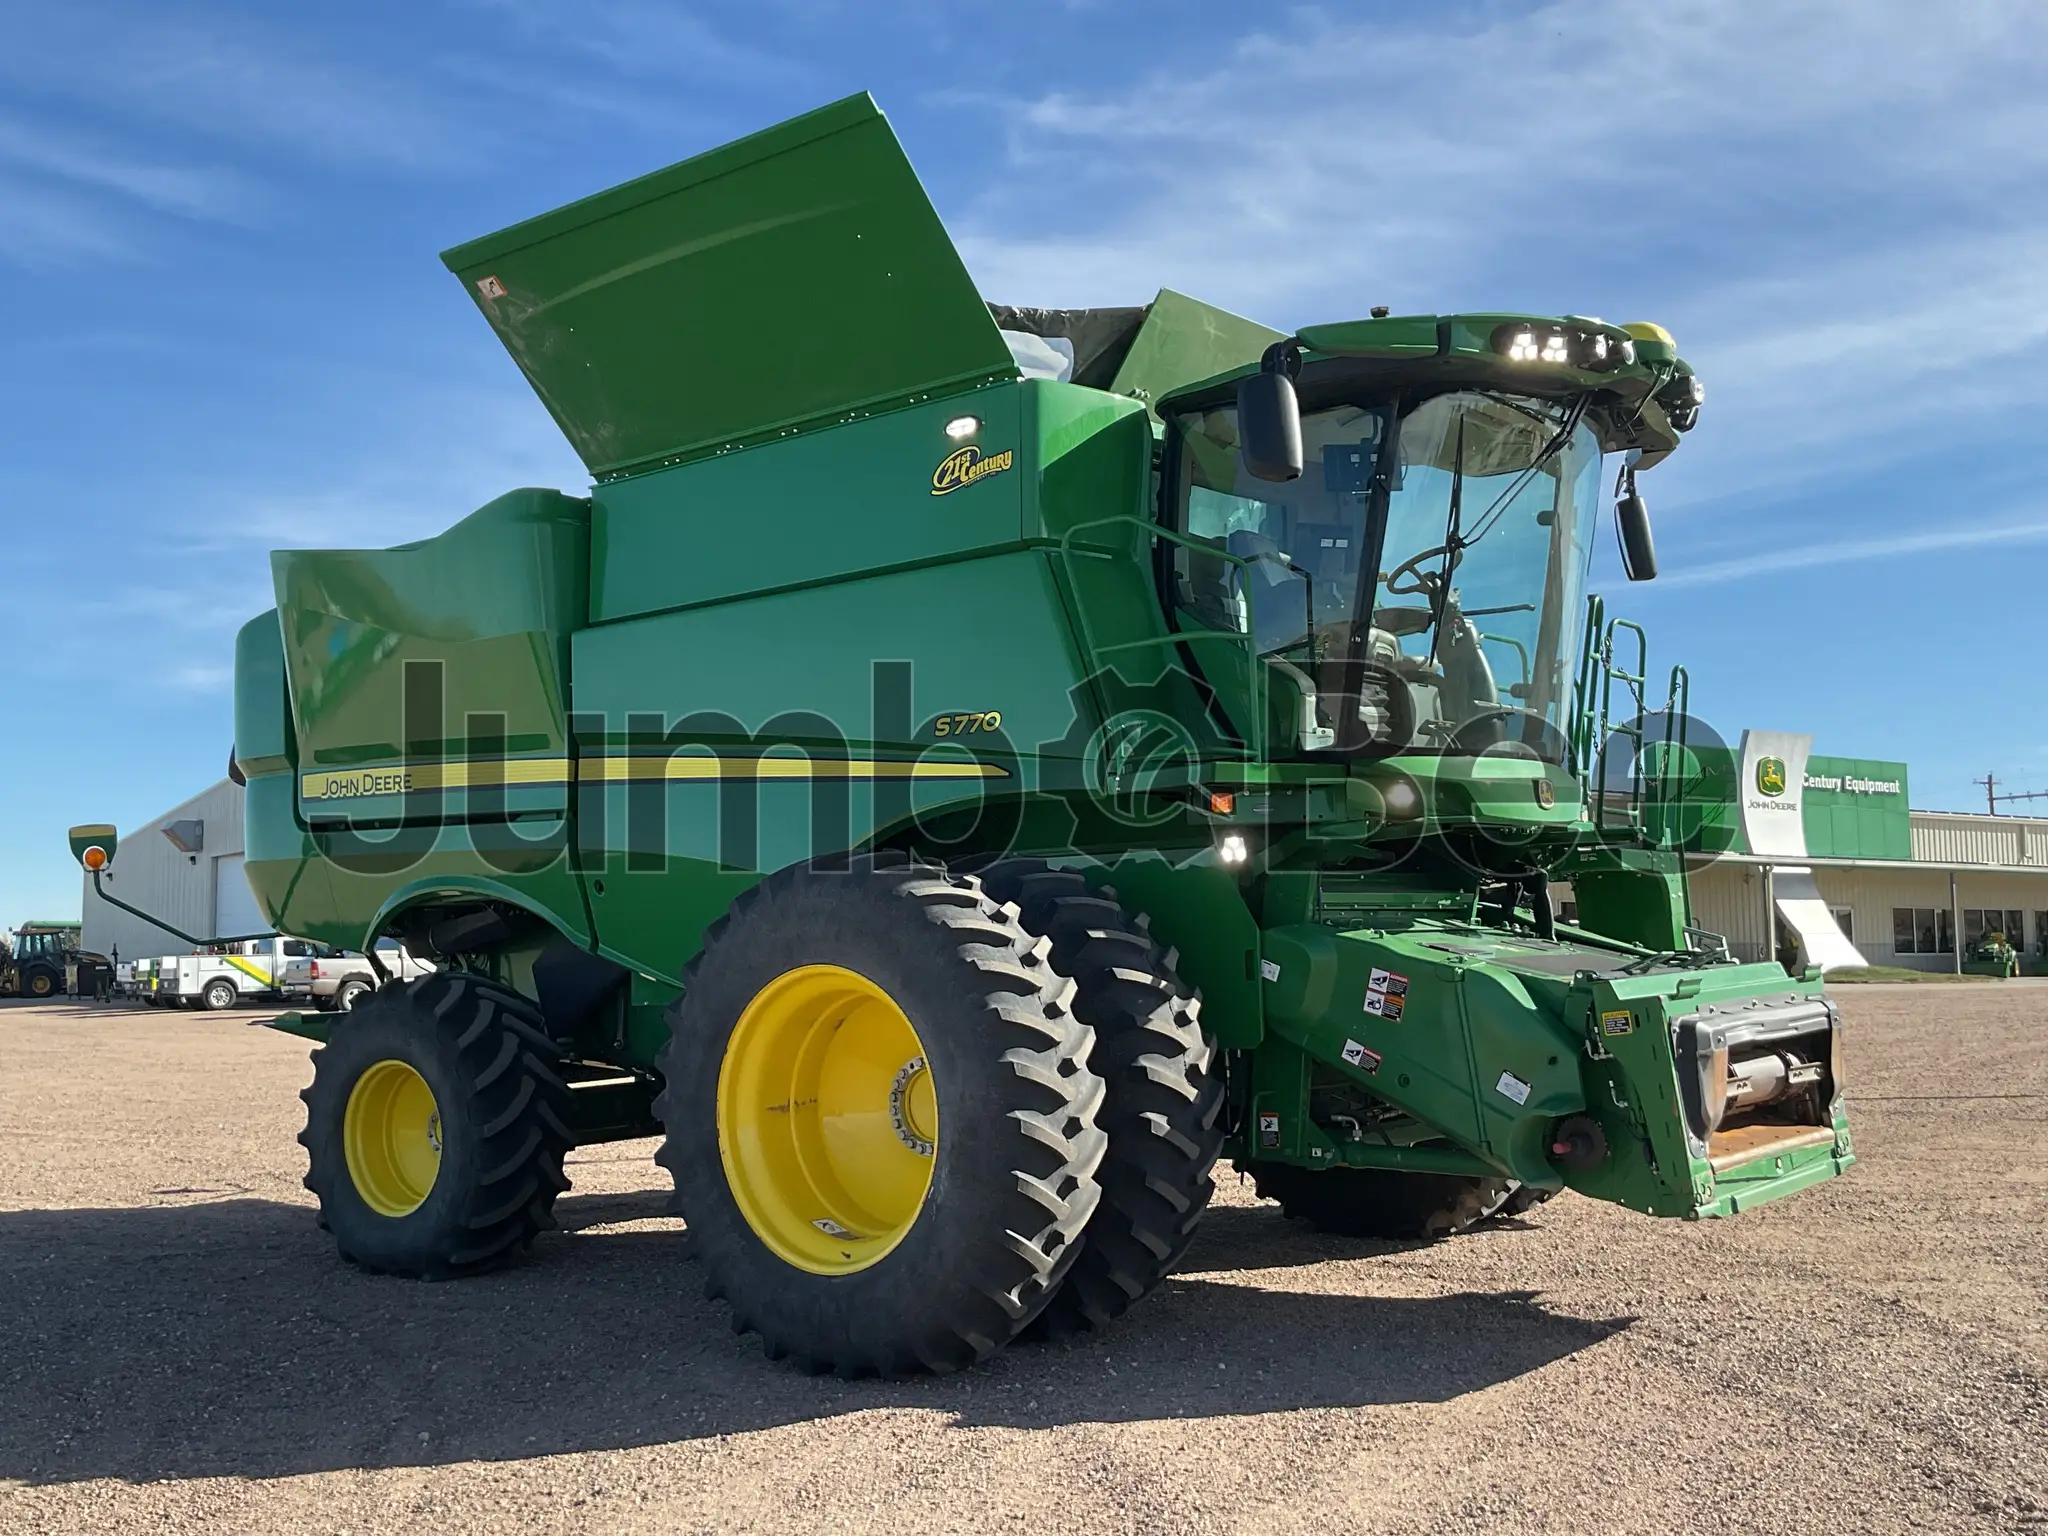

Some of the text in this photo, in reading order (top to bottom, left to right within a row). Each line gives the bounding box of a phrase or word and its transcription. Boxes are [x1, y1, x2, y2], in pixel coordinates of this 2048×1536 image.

[934, 710, 1001, 737] S770
[321, 773, 413, 798] JOHN DEERE
[1802, 773, 1901, 794] Century Equipment
[1748, 800, 1797, 812] JOHN DEERE
